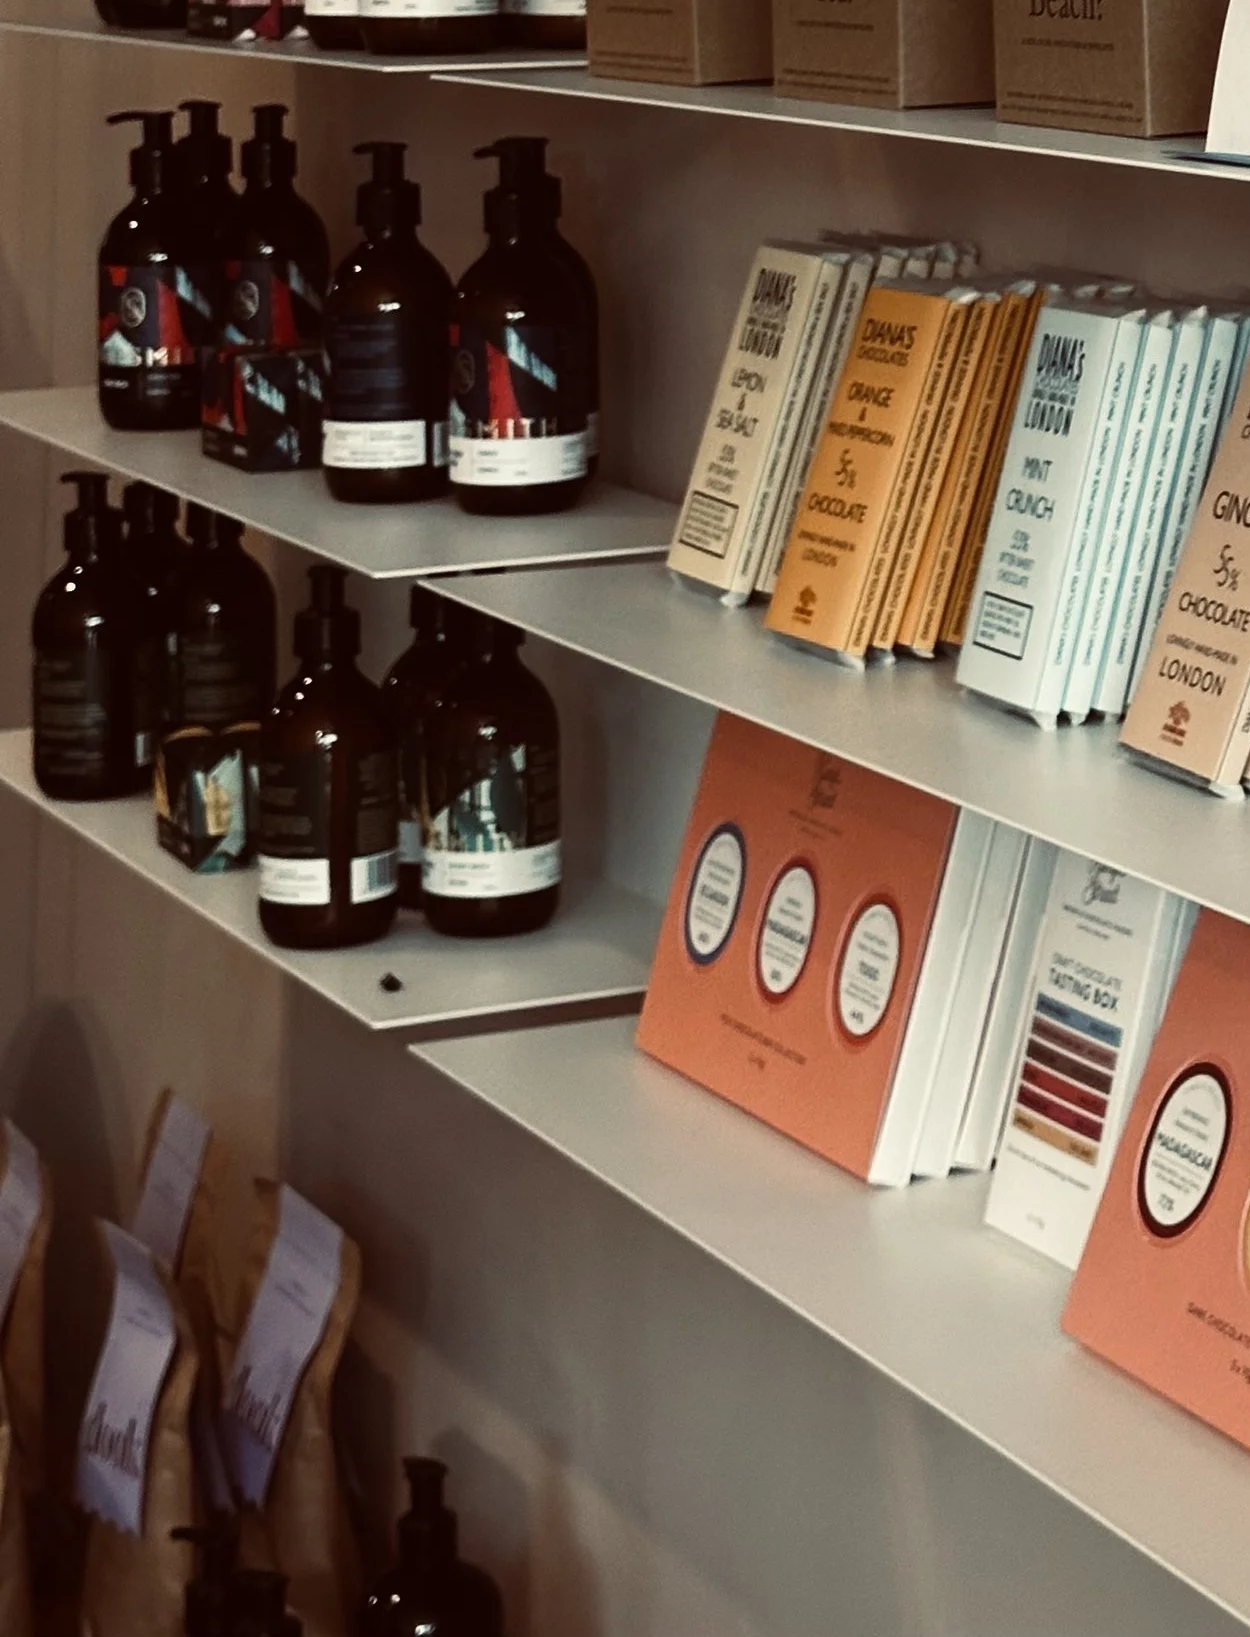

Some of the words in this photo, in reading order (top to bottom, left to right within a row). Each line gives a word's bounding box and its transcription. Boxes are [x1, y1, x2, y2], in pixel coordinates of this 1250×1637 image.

[738, 326, 784, 360] LONDON
[861, 318, 918, 350] DIANA'S
[1036, 333, 1087, 382] DIANA'S
[731, 367, 768, 394] LEMON
[847, 380, 896, 409] ORANGE
[715, 409, 736, 435] SEA
[734, 414, 760, 438] SALT
[1023, 399, 1076, 437] LONDON
[1021, 455, 1054, 485] MINT
[808, 492, 869, 525] CHOCOLATE
[1005, 486, 1056, 522] CRUNCH
[1212, 543, 1242, 592] 55%
[1158, 657, 1227, 698] LONDON
[1050, 966, 1091, 1001] TASTING
[1093, 987, 1119, 1012] BOX
